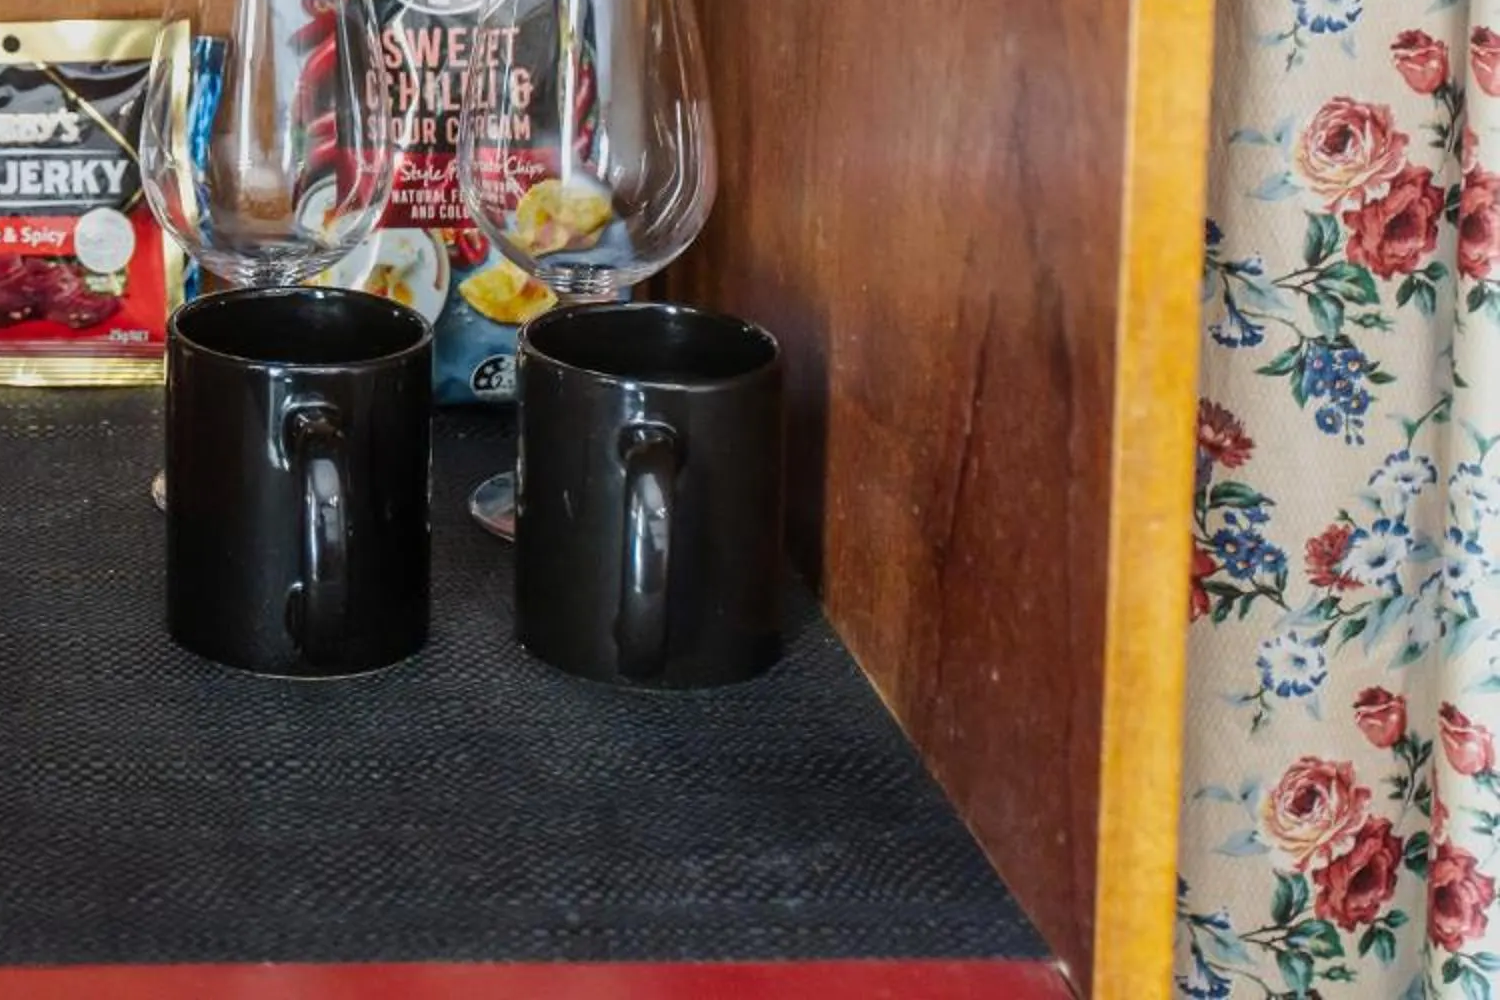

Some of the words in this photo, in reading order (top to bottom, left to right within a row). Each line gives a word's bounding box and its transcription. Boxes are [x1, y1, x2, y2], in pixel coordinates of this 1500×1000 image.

[382, 25, 520, 69] SWEET
[411, 206, 436, 220] AND
[3, 227, 18, 243] &
[19, 226, 68, 248] Spicy
